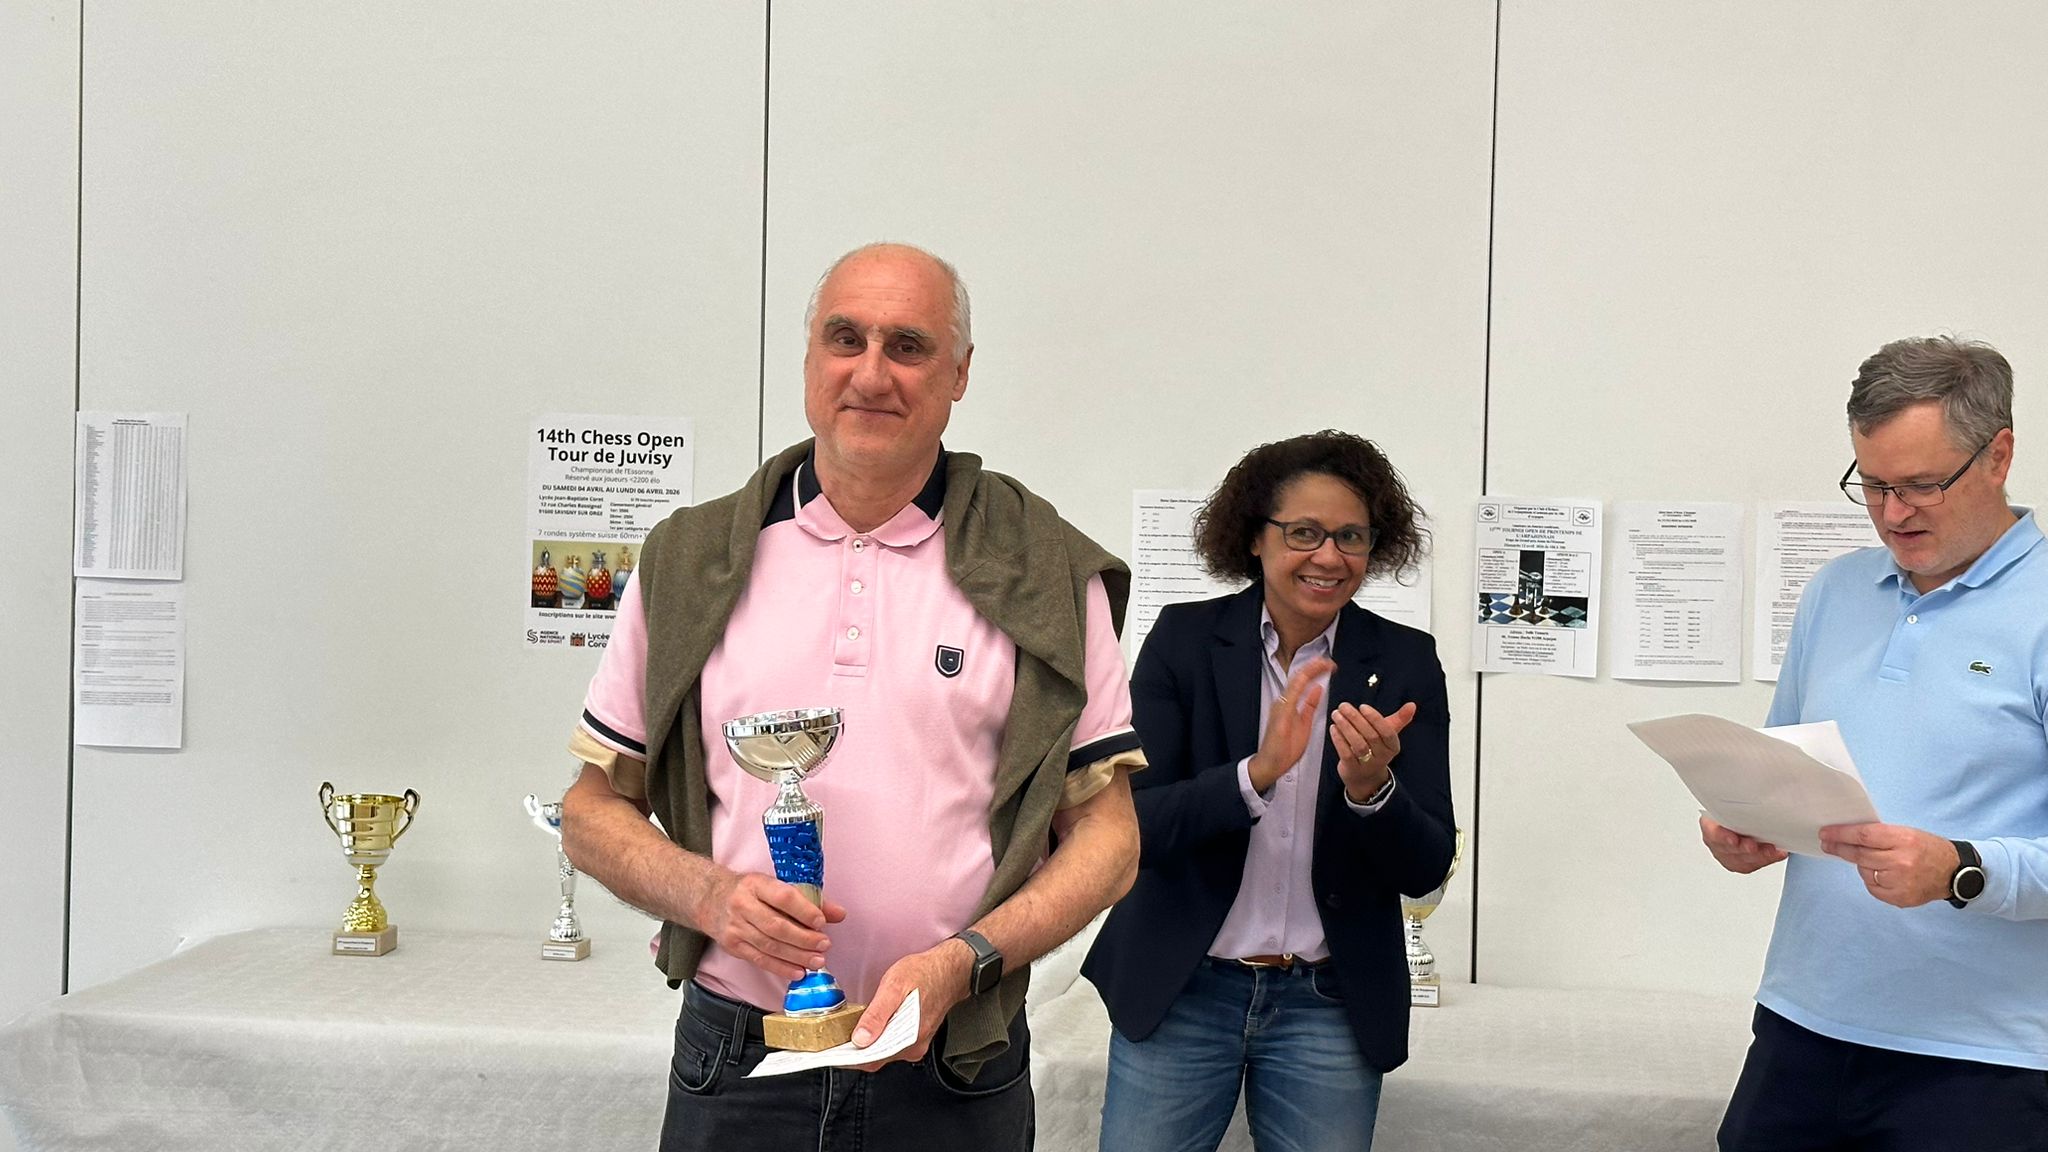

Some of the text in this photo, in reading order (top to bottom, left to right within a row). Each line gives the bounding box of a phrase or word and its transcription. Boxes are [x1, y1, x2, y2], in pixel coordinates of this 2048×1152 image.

[538, 428, 684, 450] 14th Chess Open
[548, 447, 673, 468] Tour de Juvisy
[571, 466, 613, 475] Championnat
[565, 474, 590, 482] Réservé
[630, 476, 649, 484] <2200
[650, 476, 660, 484] élo
